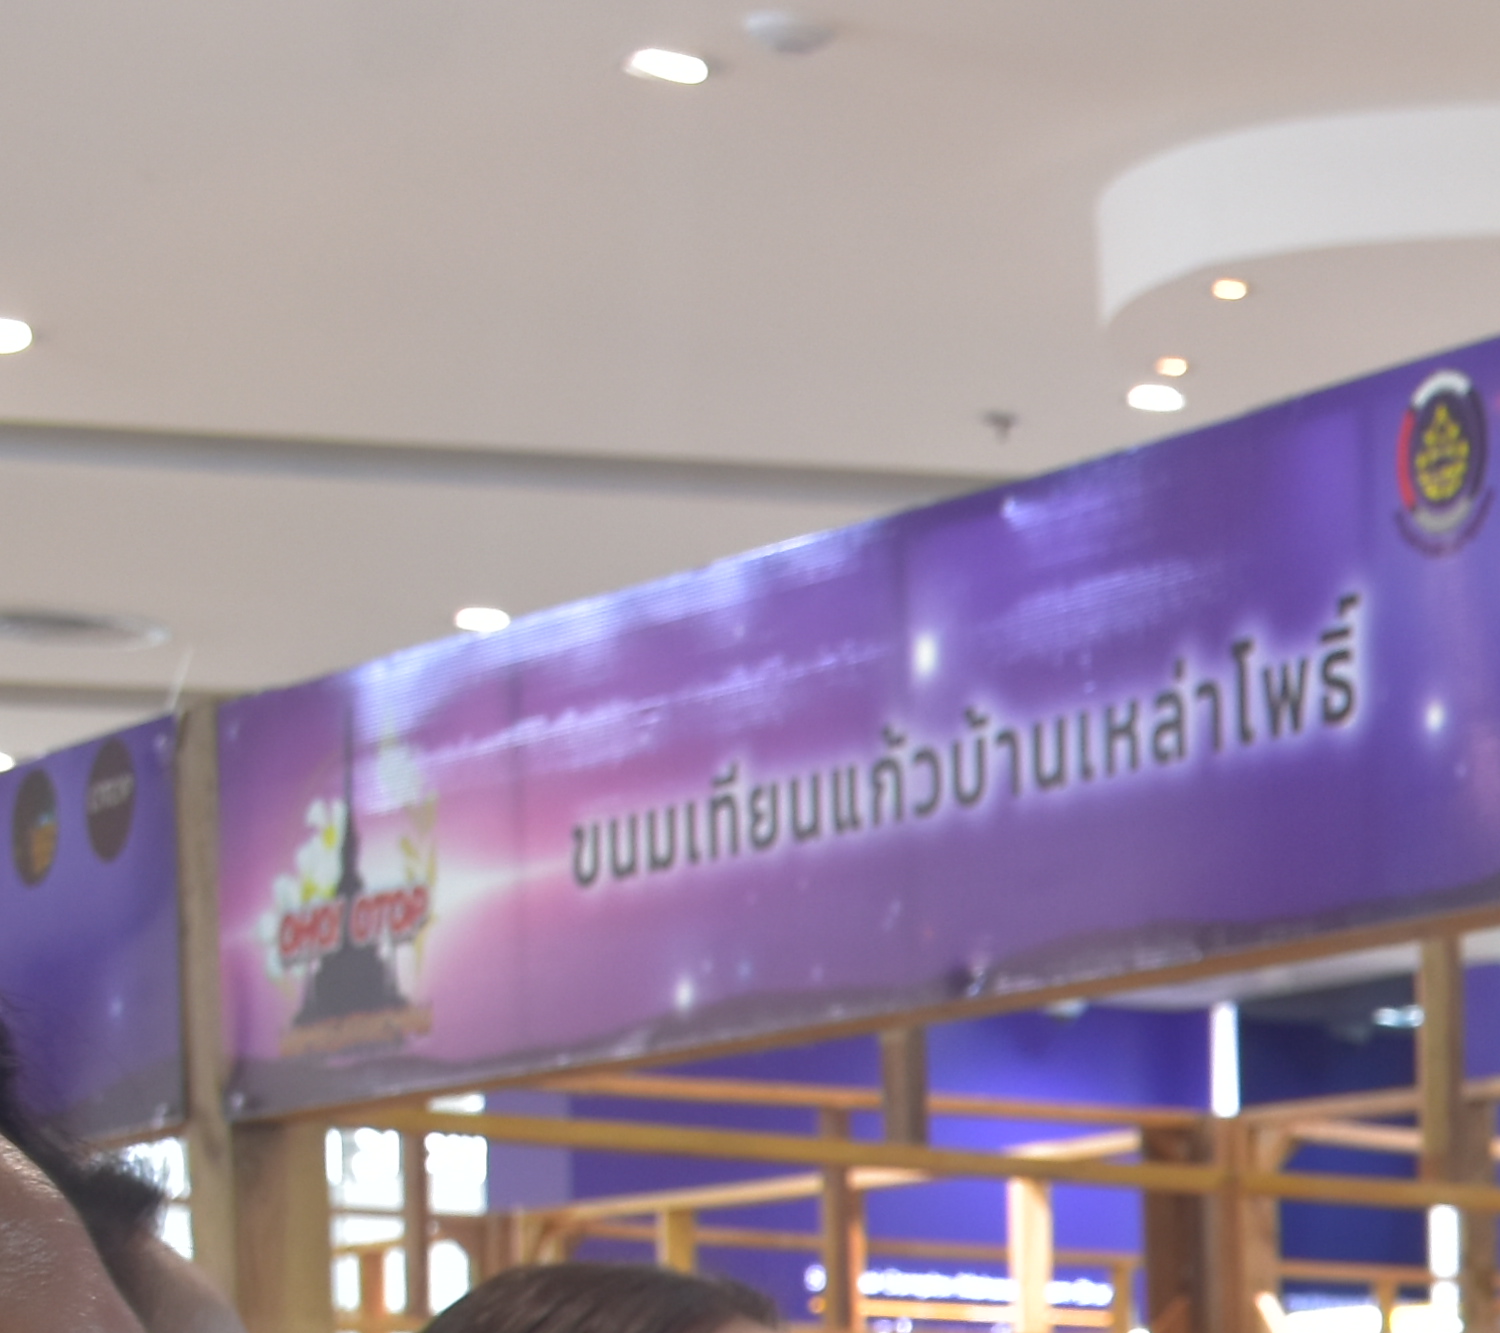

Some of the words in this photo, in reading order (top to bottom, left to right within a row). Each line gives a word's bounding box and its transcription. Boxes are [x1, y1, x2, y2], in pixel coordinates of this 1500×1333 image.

[571, 594, 1360, 888] ขนมเทียนแก้วบ้านเหล่าโพธิ์
